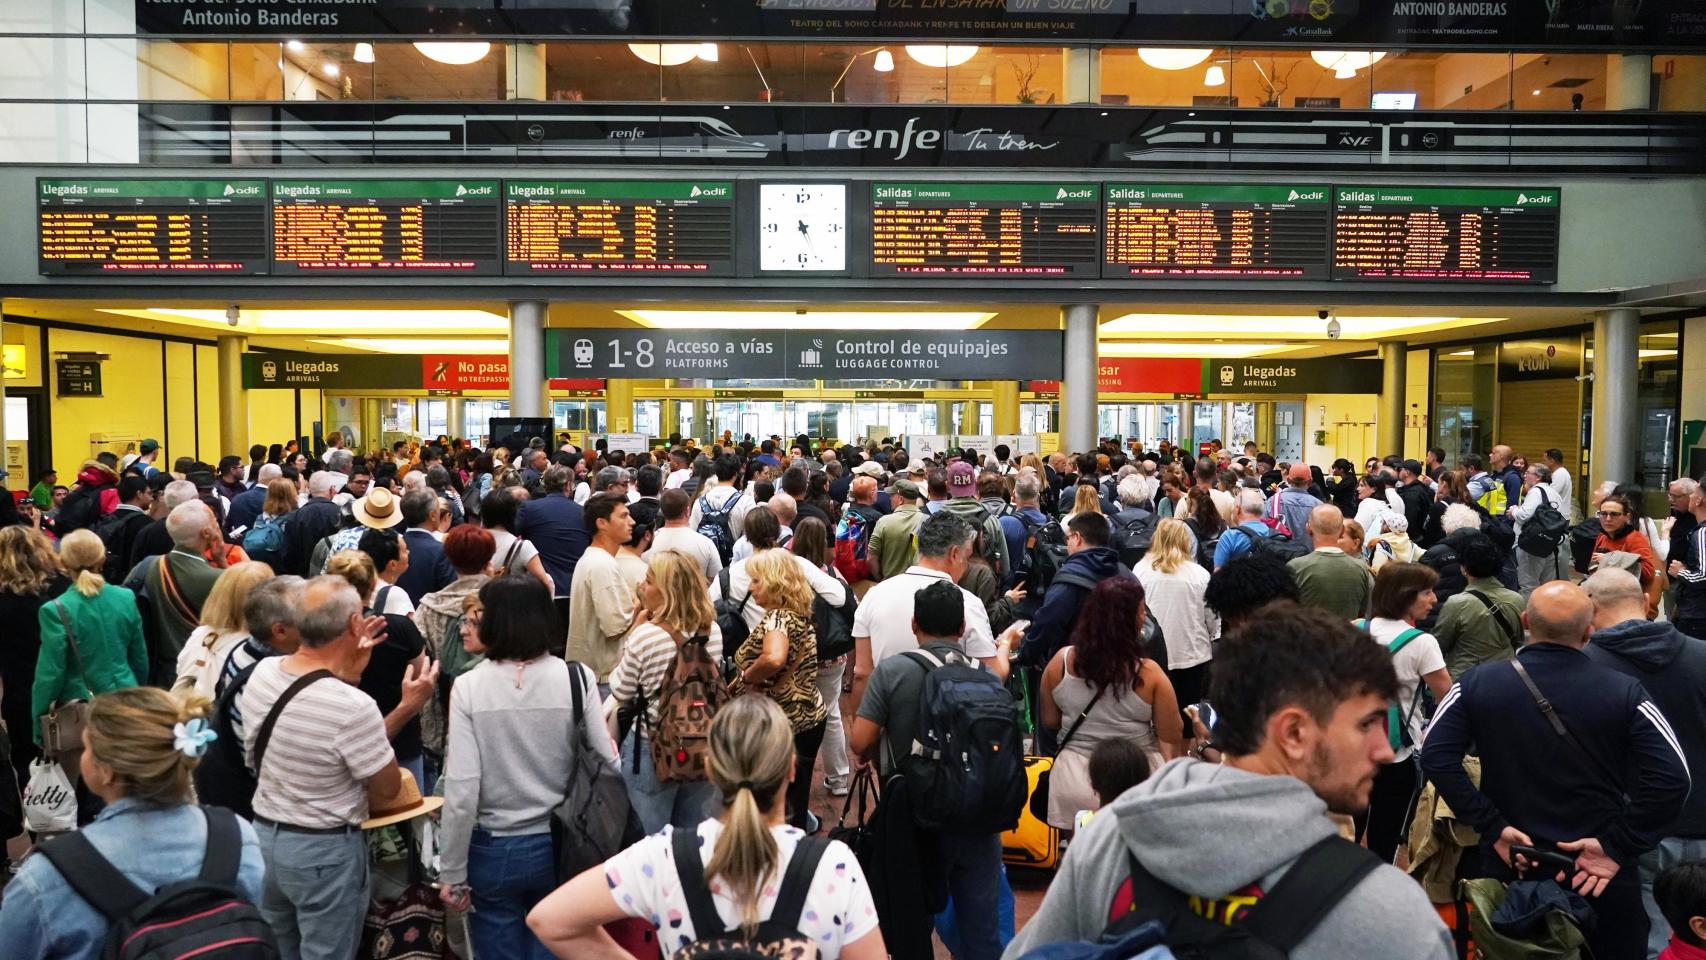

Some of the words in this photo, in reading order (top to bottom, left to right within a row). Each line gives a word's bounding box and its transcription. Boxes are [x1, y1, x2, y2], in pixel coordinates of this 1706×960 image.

[1393, 3, 1445, 16] ANTONIO
[1448, 3, 1507, 16] BANDERAS
[182, 8, 251, 25] Antonio
[258, 8, 338, 25] Banderas
[790, 19, 824, 28] TEATRO
[826, 19, 842, 28] DEL
[844, 19, 869, 28] SOHO
[871, 20, 922, 28] CAIXABANK
[931, 21, 959, 29] RENFE
[962, 21, 971, 29] TE
[974, 21, 1010, 29] DESEAN
[1025, 22, 1049, 30] BUEN
[1050, 22, 1075, 30] VIAJE
[610, 126, 645, 142] renfe
[827, 116, 941, 161] renfe
[962, 128, 992, 151] Tu
[998, 129, 1060, 151] tren
[1338, 136, 1374, 147] AVE
[43, 184, 89, 196] Llegadas
[237, 186, 262, 195] adif
[275, 185, 320, 196] Llegadas
[468, 186, 492, 195] adif
[509, 185, 554, 197] Llegadas
[702, 187, 727, 196] adif
[876, 187, 912, 198] Salidas
[1068, 190, 1093, 198] adif
[1110, 189, 1145, 199] Salidas
[796, 193, 811, 204] 12
[1300, 192, 1324, 200] adif
[1340, 191, 1375, 201] Salidas
[1529, 195, 1552, 204] adif
[768, 223, 778, 233] 9
[828, 223, 838, 233] 3
[798, 253, 808, 264] 6
[665, 339, 720, 354] Acceso
[725, 342, 735, 354] a
[740, 338, 774, 354] vías
[835, 339, 895, 355] Control
[901, 340, 921, 355] de
[927, 340, 1008, 358] equipajes
[607, 338, 655, 368] 1-8
[285, 361, 339, 375] Llegadas
[458, 361, 474, 373] No
[479, 363, 508, 375] pasa
[665, 358, 729, 368] PLATFORMS
[835, 359, 888, 368] LUGGAGE
[890, 359, 940, 369] CONTROL
[1243, 365, 1297, 379] Llegadas
[953, 474, 972, 485] RM
